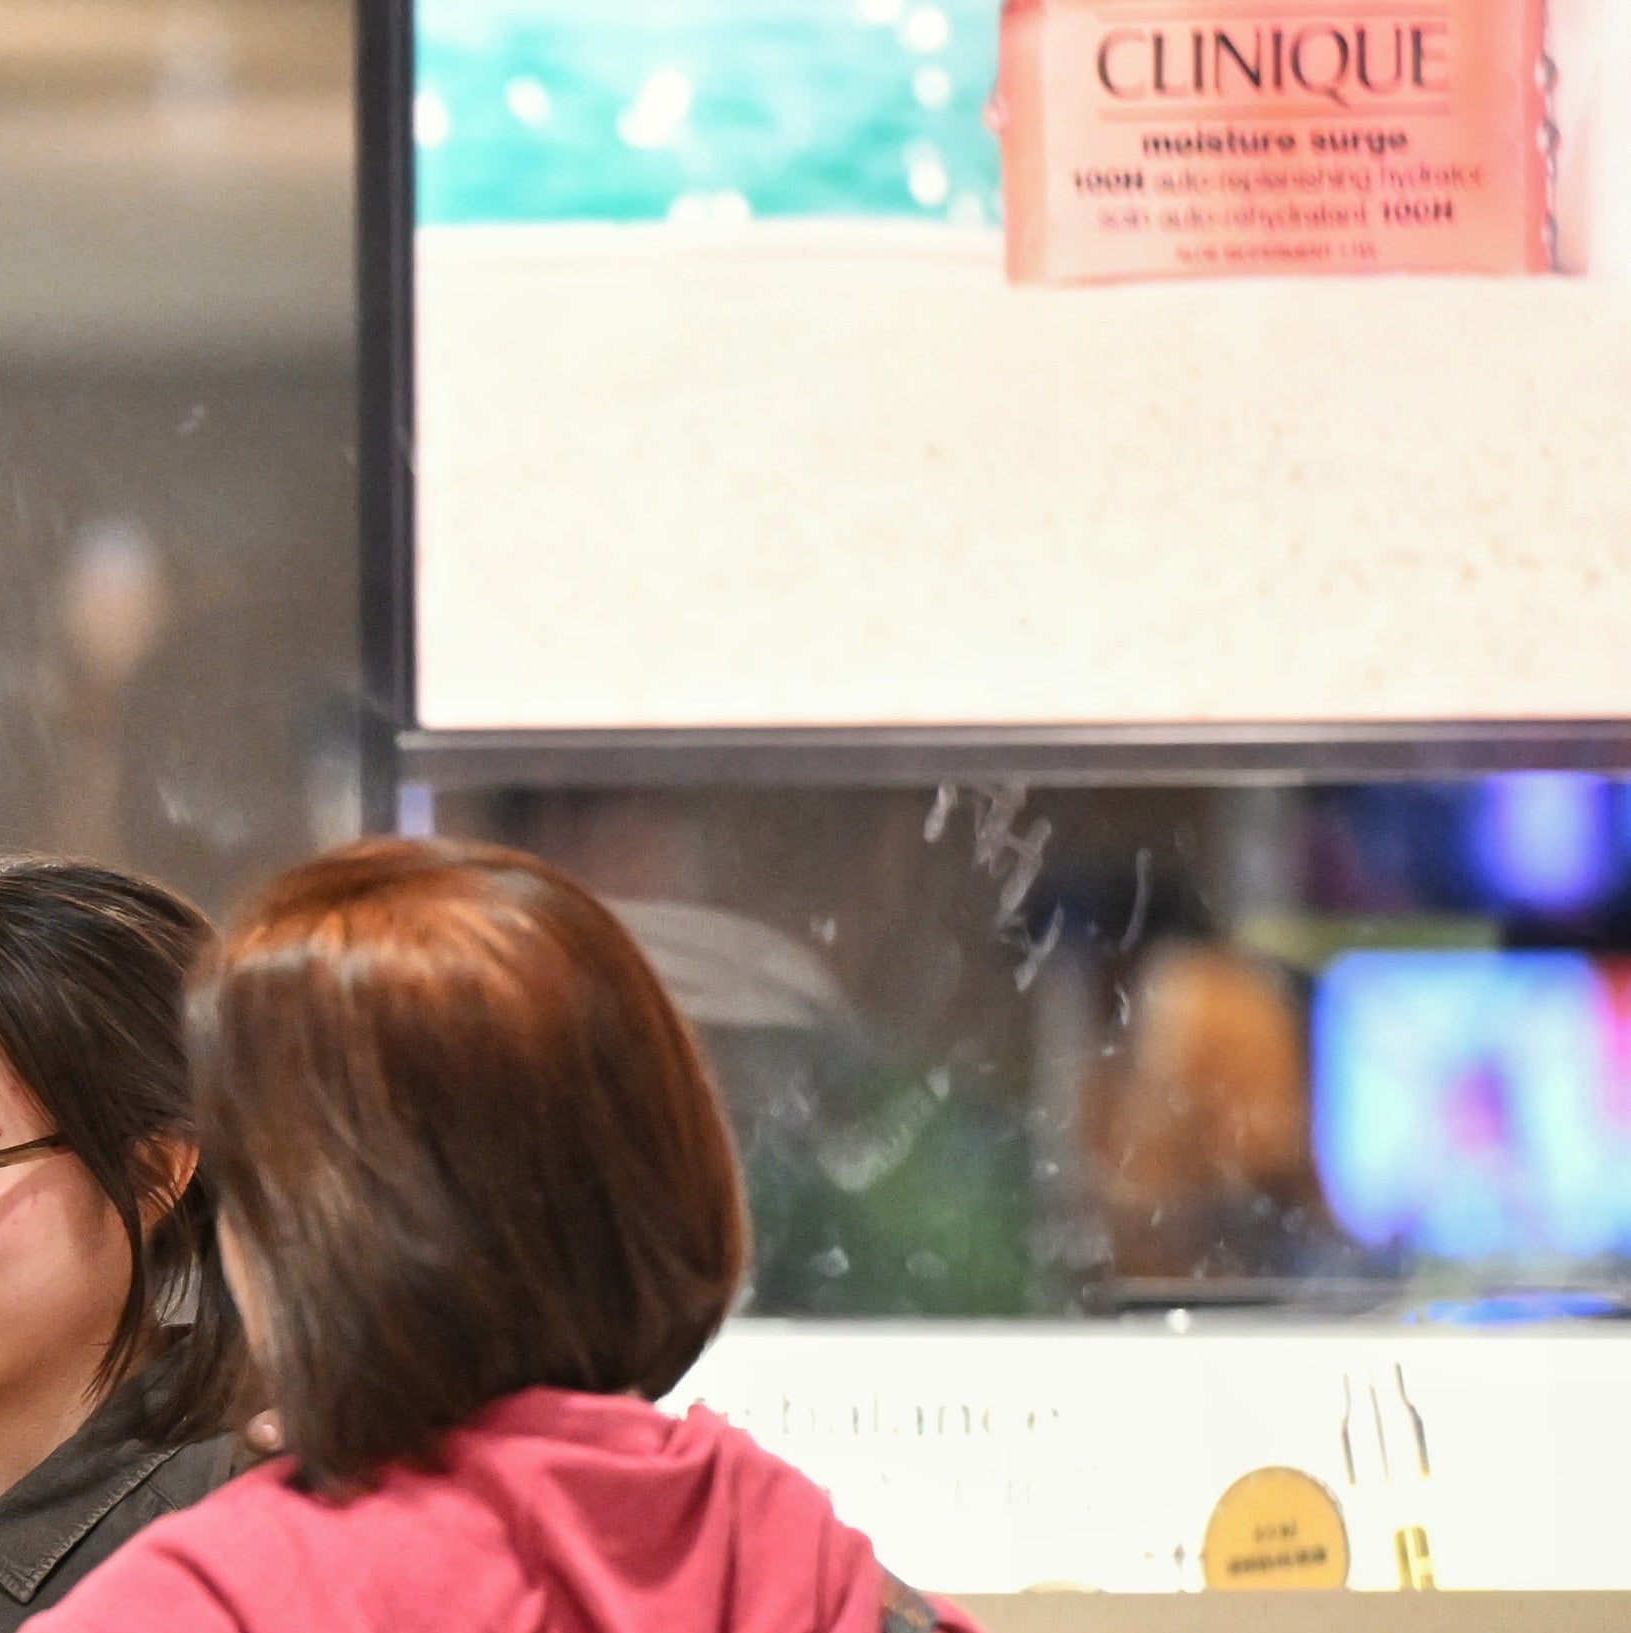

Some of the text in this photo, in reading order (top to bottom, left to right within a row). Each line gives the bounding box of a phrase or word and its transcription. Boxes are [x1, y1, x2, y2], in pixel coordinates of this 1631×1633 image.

[1096, 23, 1451, 107] CLINIQUE
[1142, 129, 1409, 156] moisture surge
